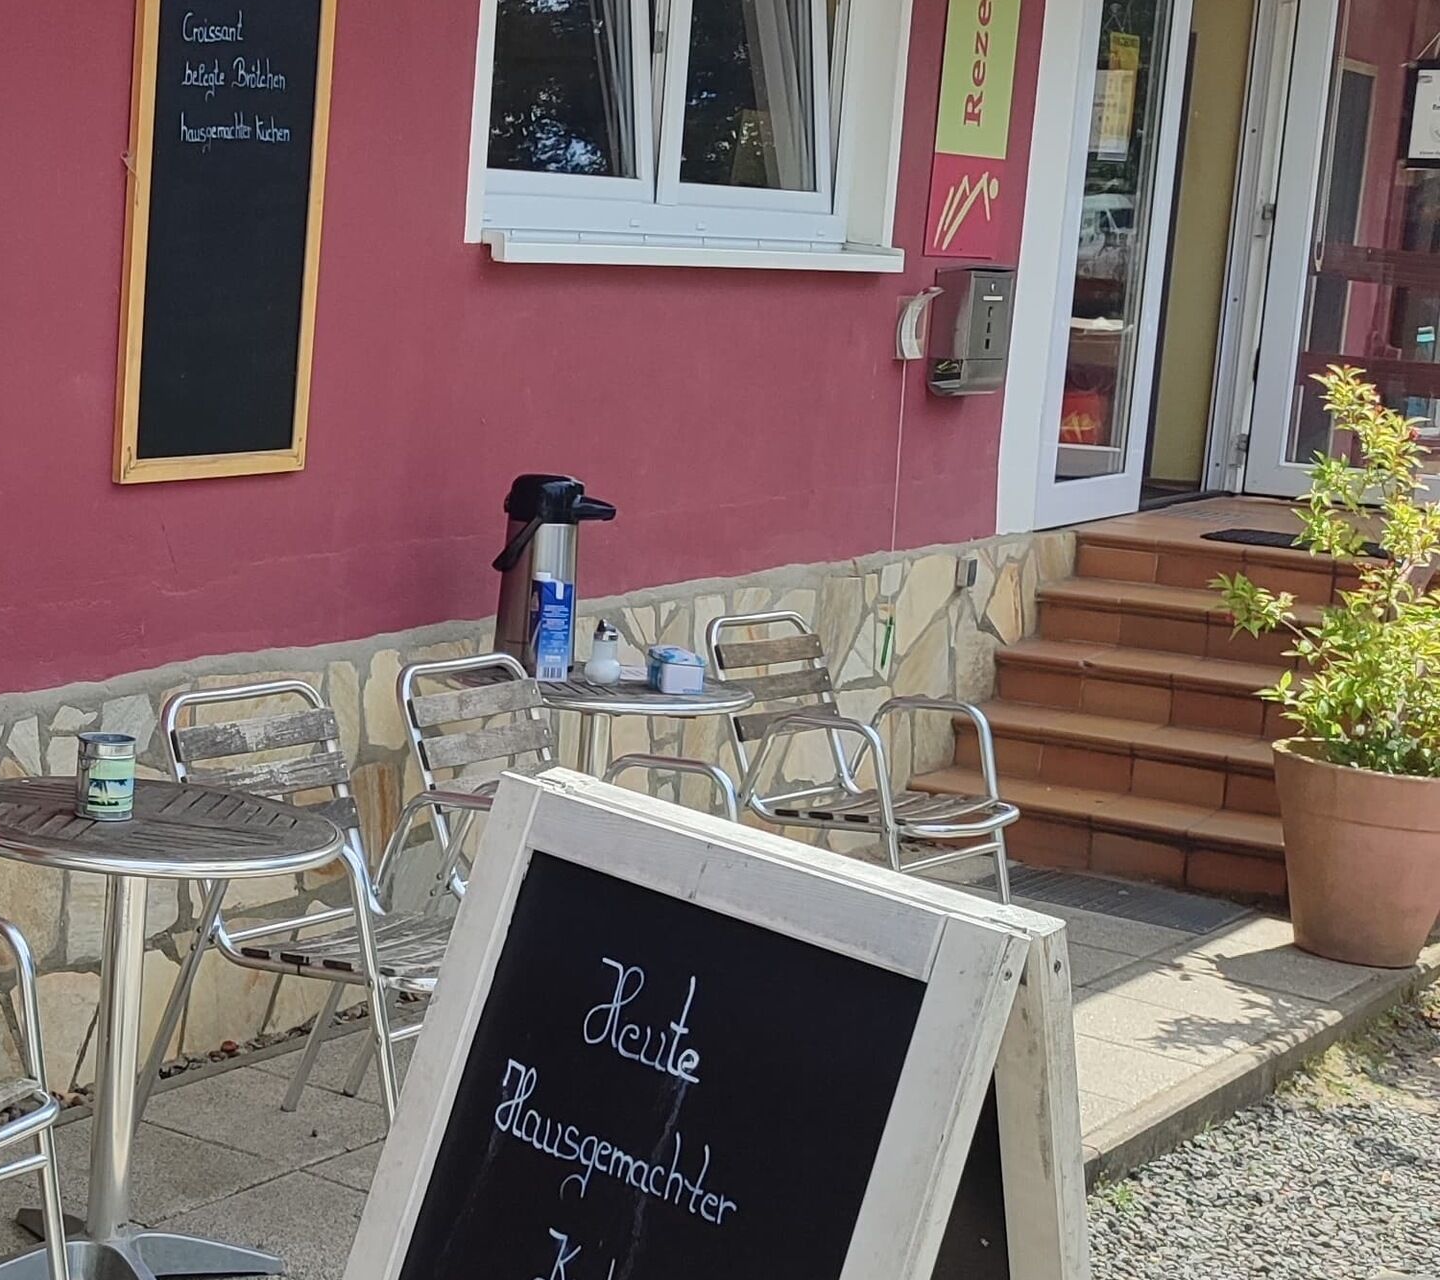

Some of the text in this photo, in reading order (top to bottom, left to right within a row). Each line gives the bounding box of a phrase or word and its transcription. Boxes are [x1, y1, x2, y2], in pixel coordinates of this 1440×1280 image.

[182, 9, 244, 42] Croissant
[181, 56, 286, 102] belegte Brötchen
[180, 111, 291, 154] hausgemachter Kuchen
[583, 957, 700, 1083] Heute
[494, 1058, 737, 1224] Hausgemachter
